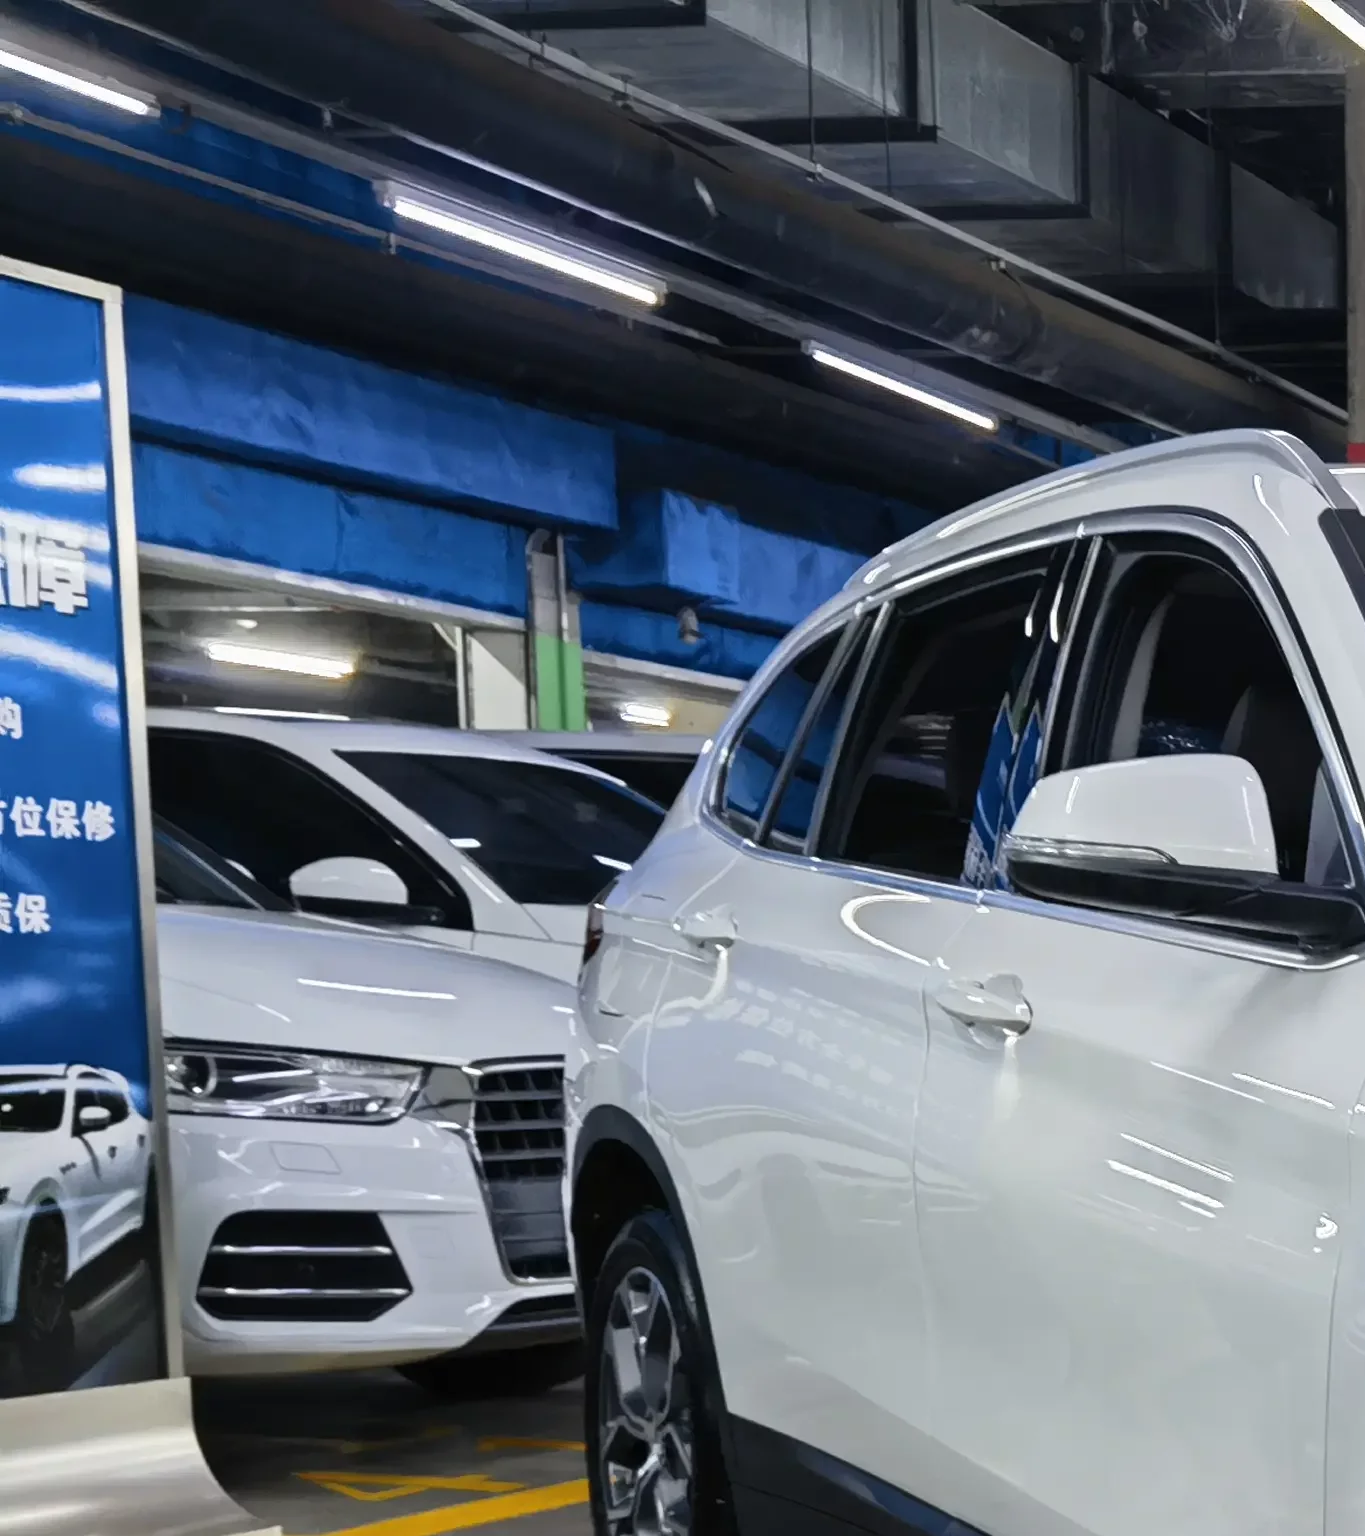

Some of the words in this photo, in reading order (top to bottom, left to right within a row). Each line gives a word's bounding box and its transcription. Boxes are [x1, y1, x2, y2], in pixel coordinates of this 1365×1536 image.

[0, 517, 89, 615] 障
[0, 796, 116, 841] 位保修
